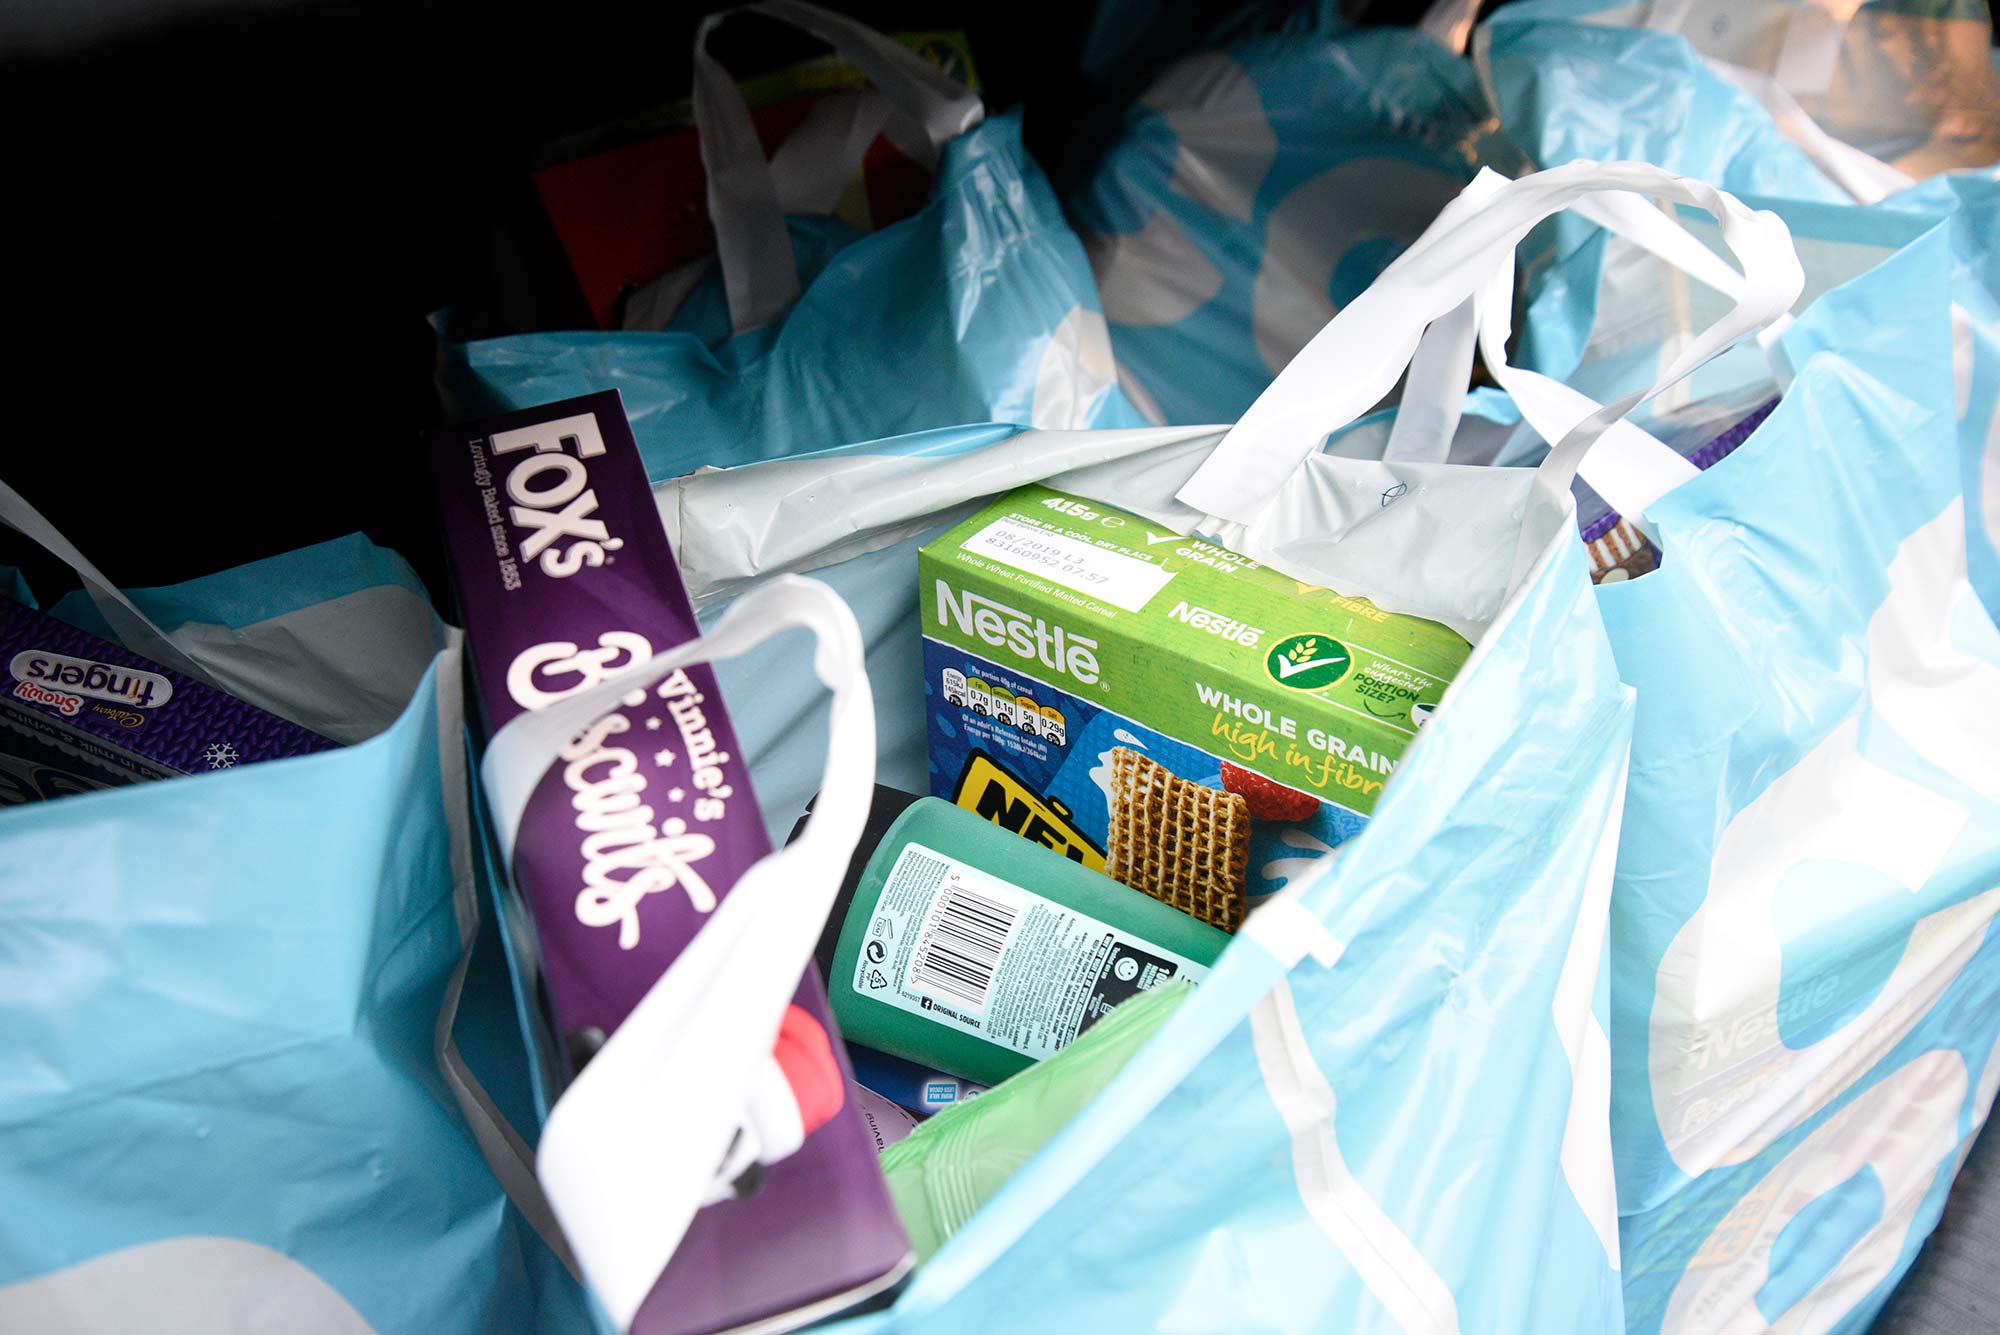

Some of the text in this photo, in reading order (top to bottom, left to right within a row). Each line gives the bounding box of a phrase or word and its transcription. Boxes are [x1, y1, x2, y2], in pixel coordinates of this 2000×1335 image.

[467, 437, 493, 488] Lovingly
[480, 486, 503, 525] Baked
[1042, 497, 1100, 521] 415g
[490, 524, 510, 557] since
[995, 530, 1085, 565] 08/2019 L3
[1009, 512, 1043, 526] STORE
[1042, 523, 1055, 531] IN
[1095, 540, 1118, 551] DRY
[1118, 547, 1153, 562] PLACE
[1175, 547, 1239, 573] GRAIN
[1191, 540, 1264, 570] WHOLE
[957, 552, 1118, 618] Whole Wheat Fortified Malted Cereal
[1330, 597, 1392, 623] FIBRE
[27, 659, 154, 706] fingers
[947, 672, 962, 681] Energy
[1353, 673, 1420, 702] PORTION
[1364, 667, 1424, 692] suggested
[1372, 660, 1433, 688] What's the
[16, 681, 144, 728] Cadbury Snowy
[970, 690, 989, 705] 0.7g
[995, 700, 1014, 714] 0.1g
[1355, 683, 1396, 704] SIZE?
[6, 709, 56, 736] white
[1022, 711, 1034, 723] 5g
[1040, 719, 1065, 736] 0.29g
[1195, 682, 1399, 776] WHOLE GRAIN
[79, 739, 115, 761] milk
[657, 668, 733, 822] Vinnie's
[1211, 712, 1385, 795] high in fibr
[506, 630, 716, 950] Bscuits
[976, 778, 1084, 864] NE
[950, 873, 959, 882] 5
[928, 887, 952, 928] 000101
[912, 931, 933, 973] 845208
[856, 960, 868, 988] Recyclable
[932, 1003, 981, 1029] ORIGINAL SOURCE
